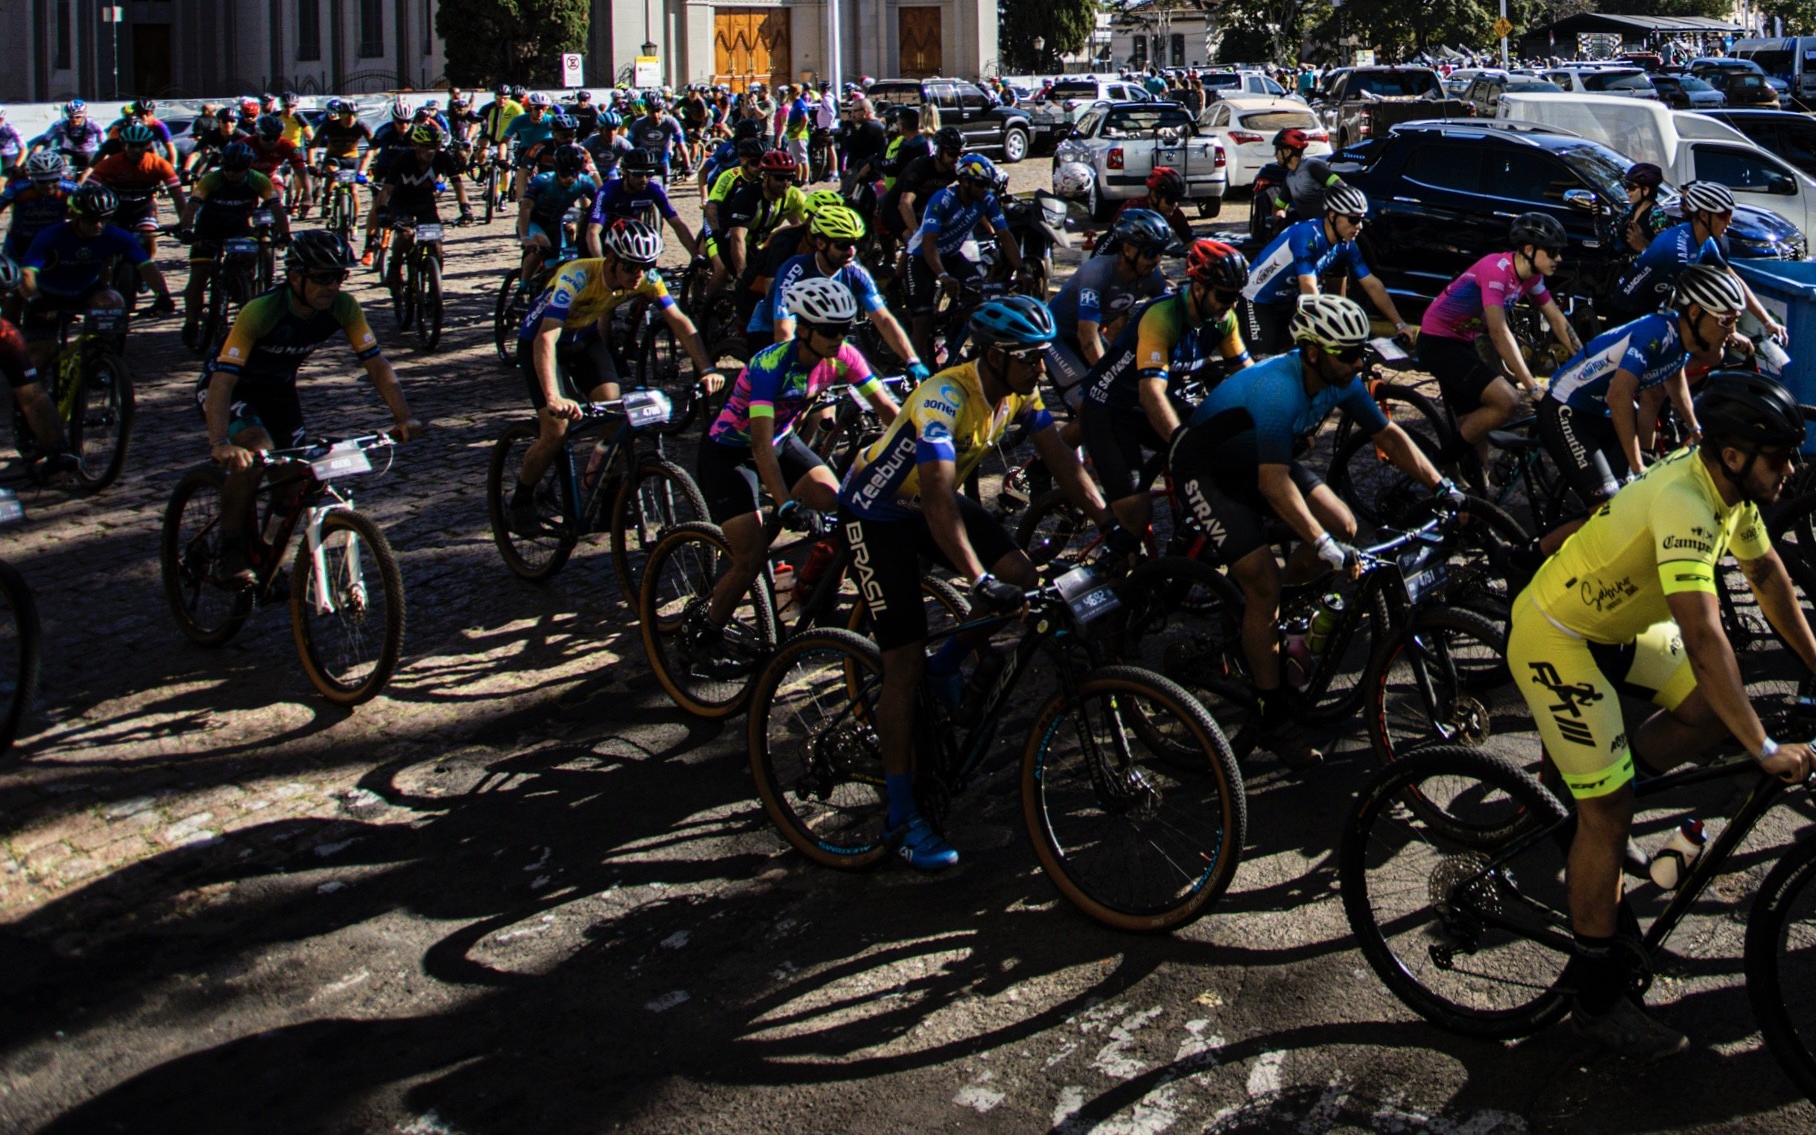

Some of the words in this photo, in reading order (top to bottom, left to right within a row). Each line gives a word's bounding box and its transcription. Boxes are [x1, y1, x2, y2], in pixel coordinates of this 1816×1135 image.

[1246, 299, 1262, 342] anatiba
[1557, 403, 1590, 471] Canatiba
[850, 436, 918, 511] Zeeburg
[1184, 478, 1228, 548] STRAVA
[844, 520, 889, 622] BRASIL
